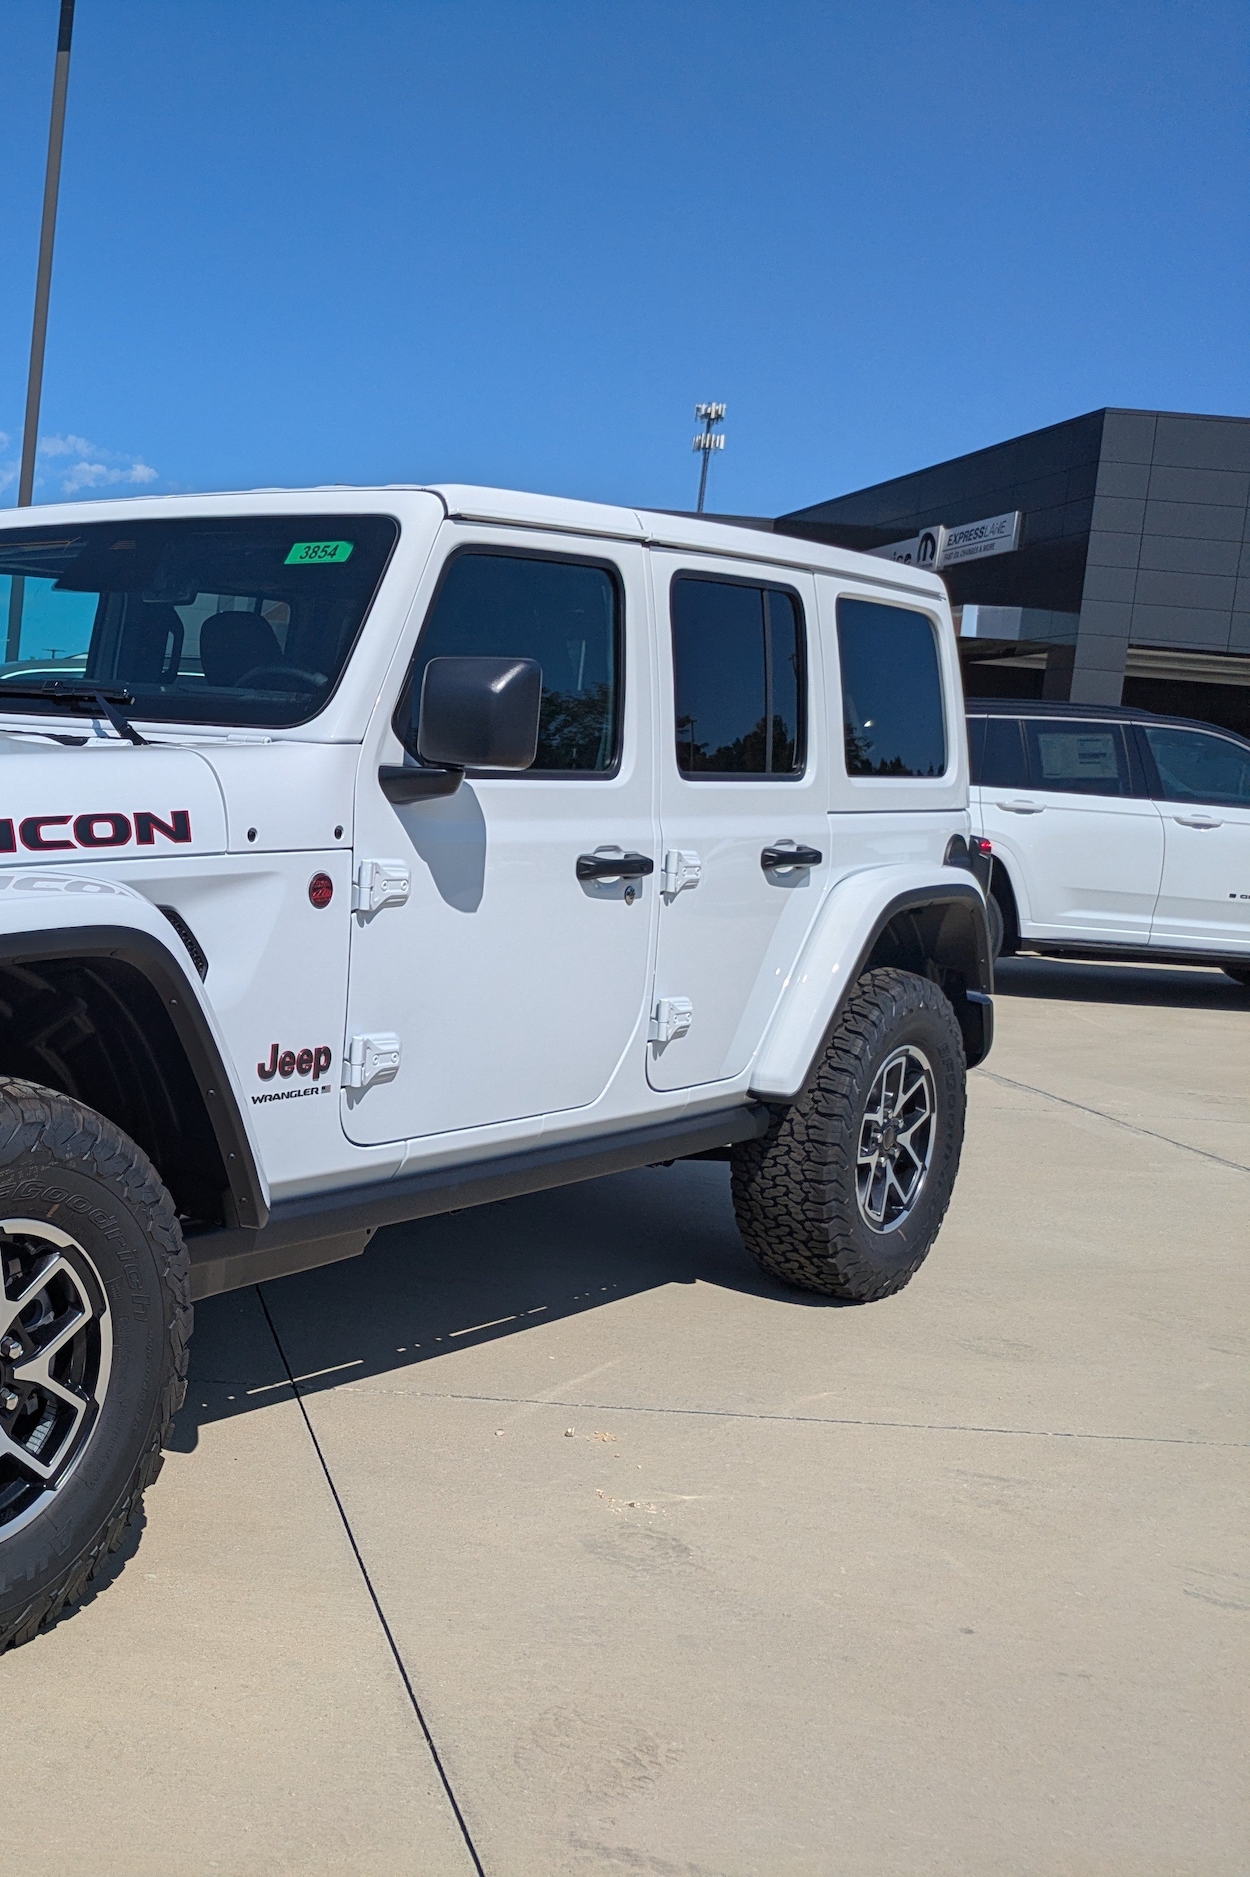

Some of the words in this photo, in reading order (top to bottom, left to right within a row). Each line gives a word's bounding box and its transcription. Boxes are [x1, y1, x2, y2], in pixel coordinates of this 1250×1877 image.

[299, 544, 340, 560] 3854
[257, 1043, 332, 1081] Jeep
[251, 1087, 319, 1105] WRANGLER
